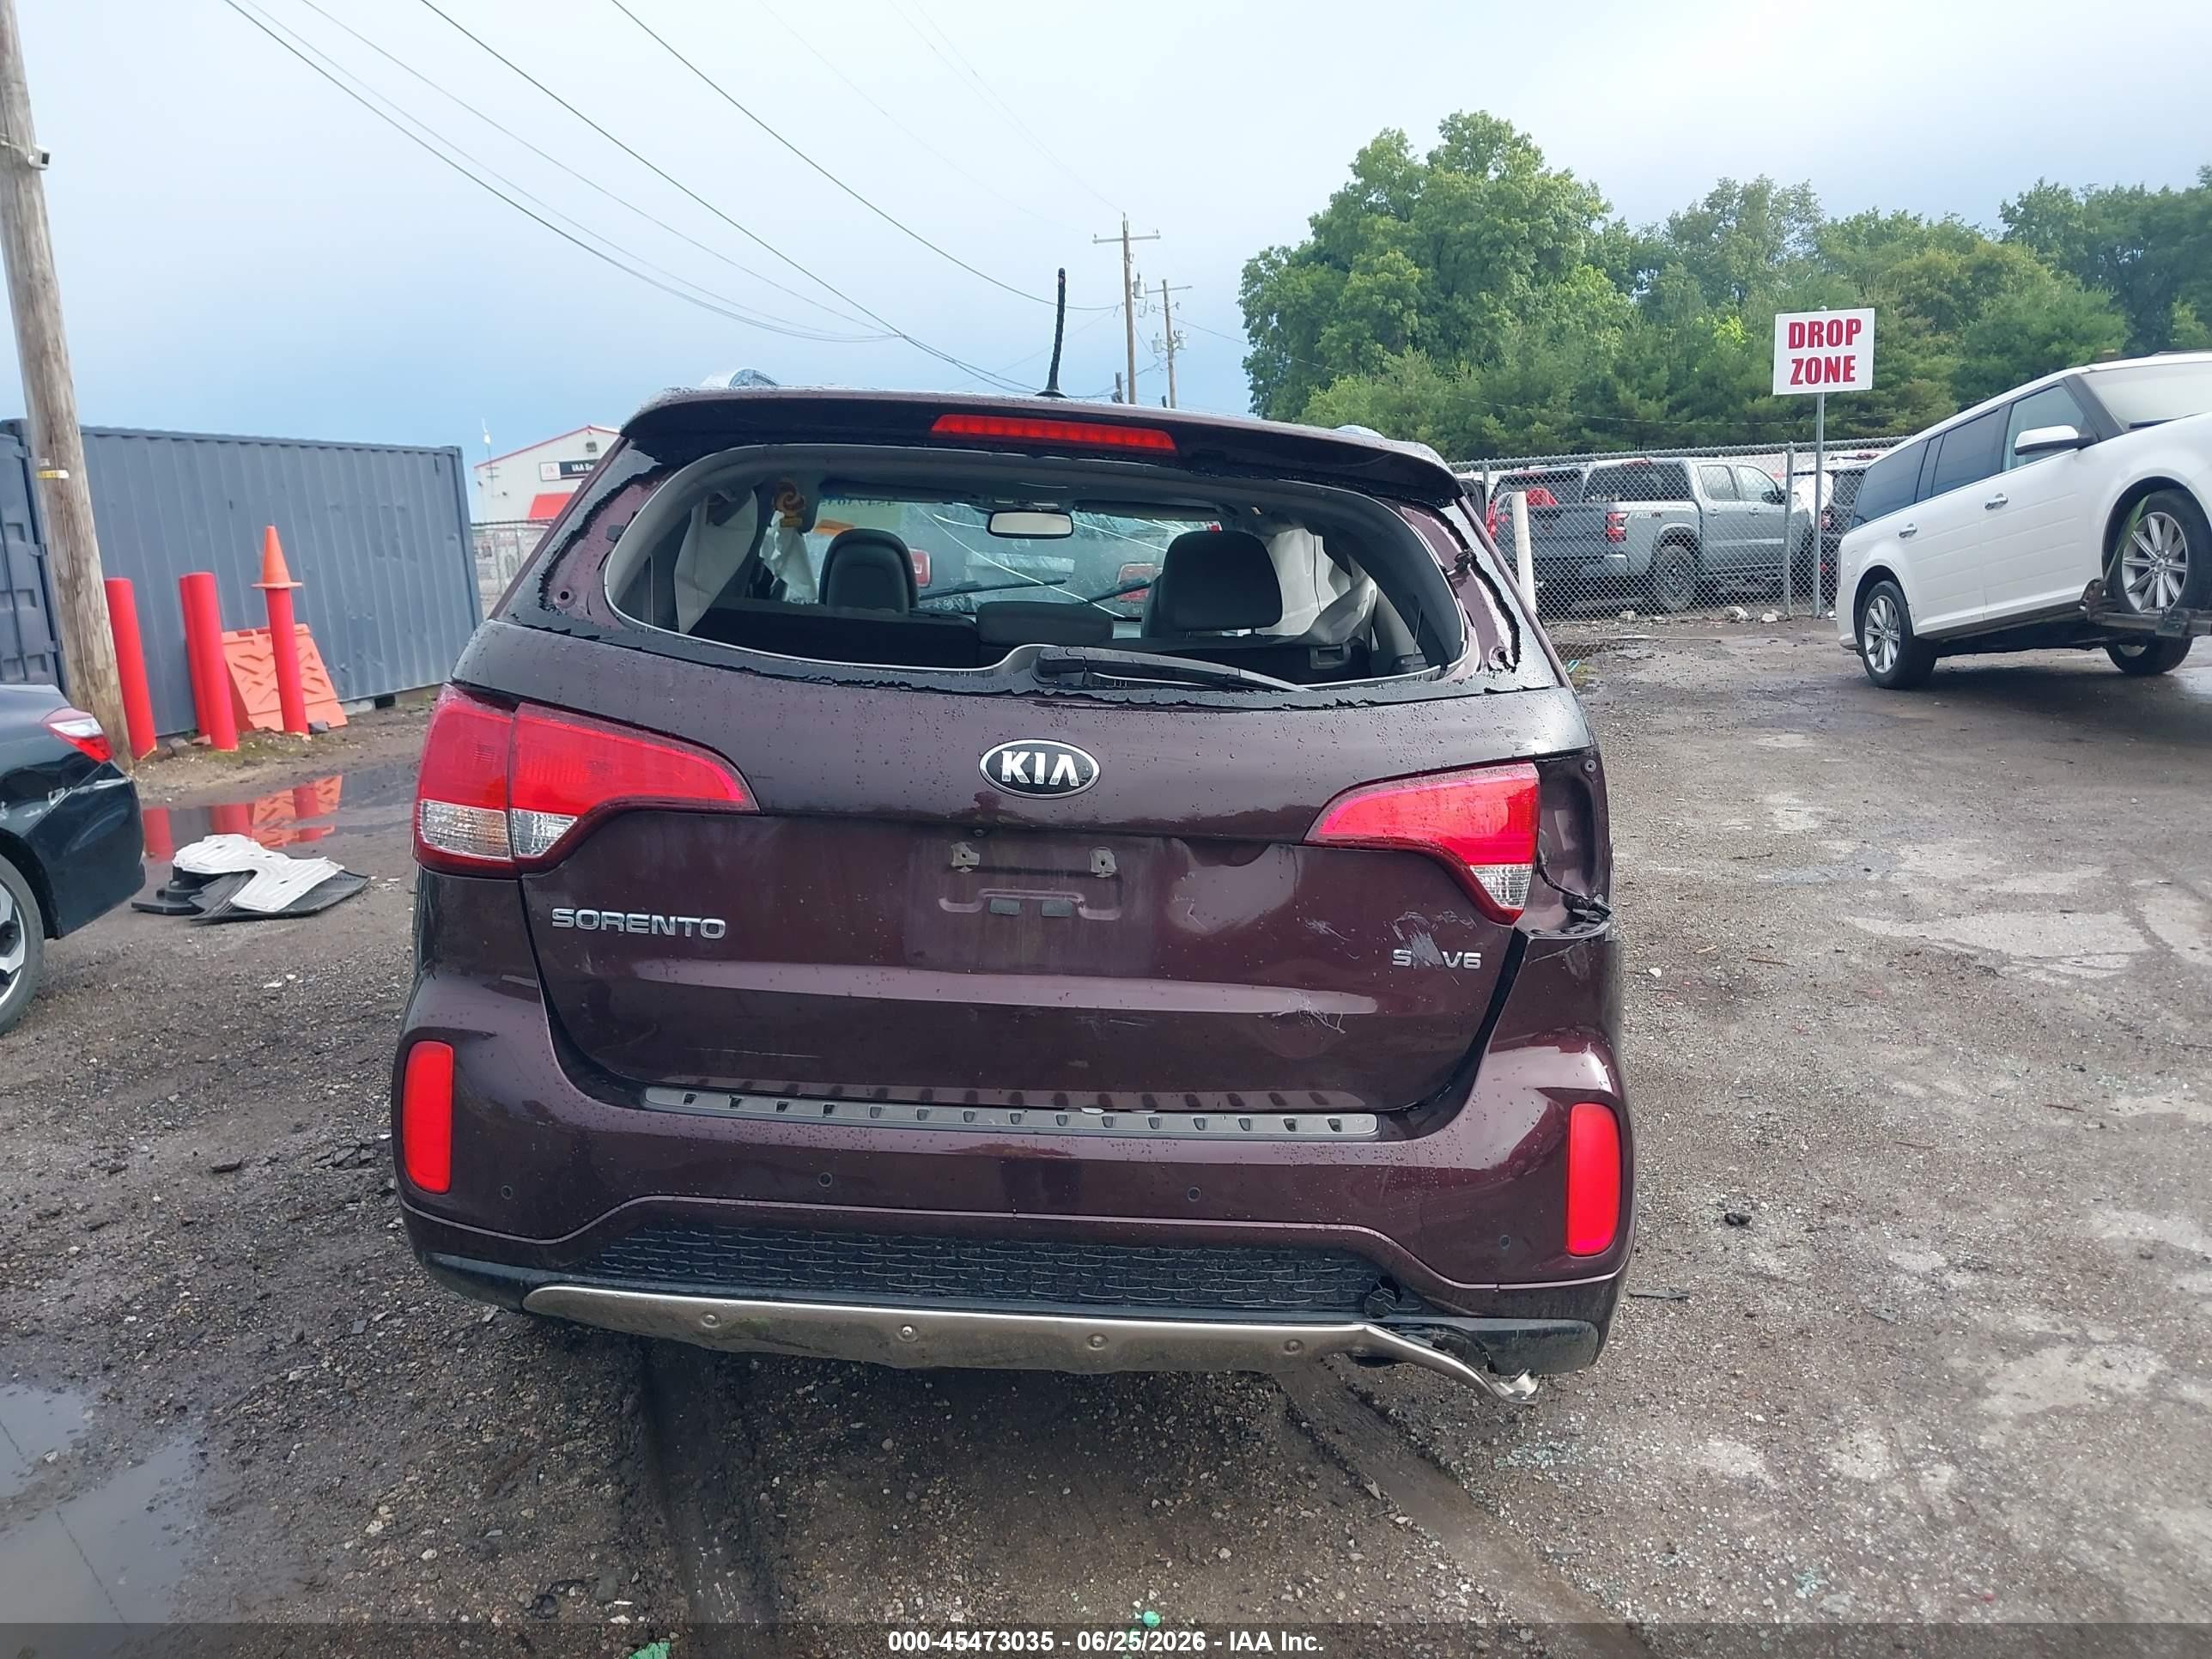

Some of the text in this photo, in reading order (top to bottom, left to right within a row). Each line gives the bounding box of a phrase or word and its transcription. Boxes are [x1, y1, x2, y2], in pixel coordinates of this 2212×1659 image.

[1788, 319, 1862, 349] DROP
[1790, 355, 1856, 386] ZONE
[1001, 750, 1079, 787] KIA
[551, 908, 726, 939] SORENTO
[1442, 951, 1482, 969] V6
